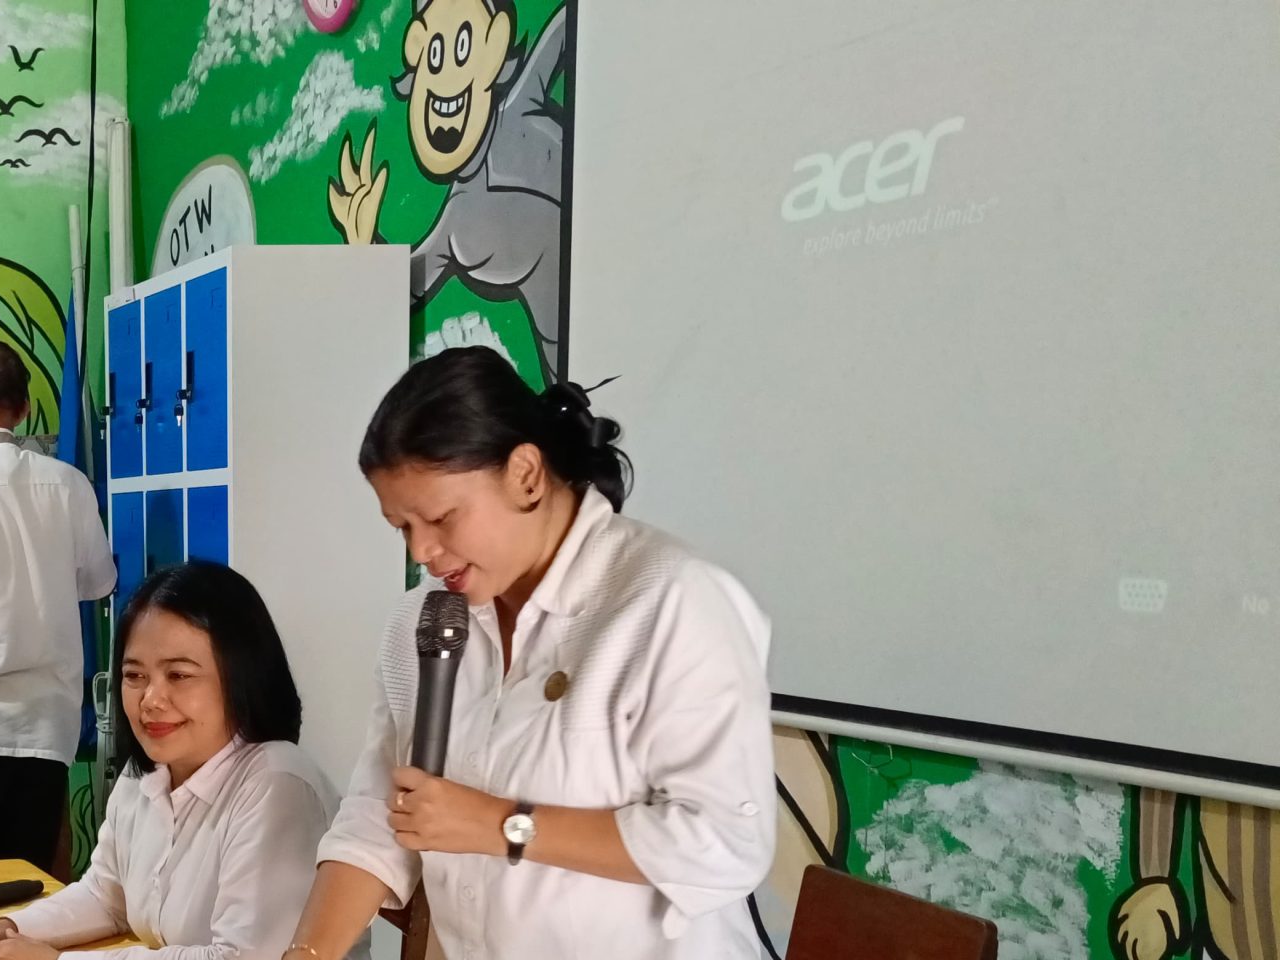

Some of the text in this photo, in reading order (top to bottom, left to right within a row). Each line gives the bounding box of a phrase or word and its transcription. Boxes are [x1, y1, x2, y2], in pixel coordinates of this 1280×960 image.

[781, 116, 965, 222] acer
[170, 184, 212, 266] OTW
[864, 211, 930, 246] beyond
